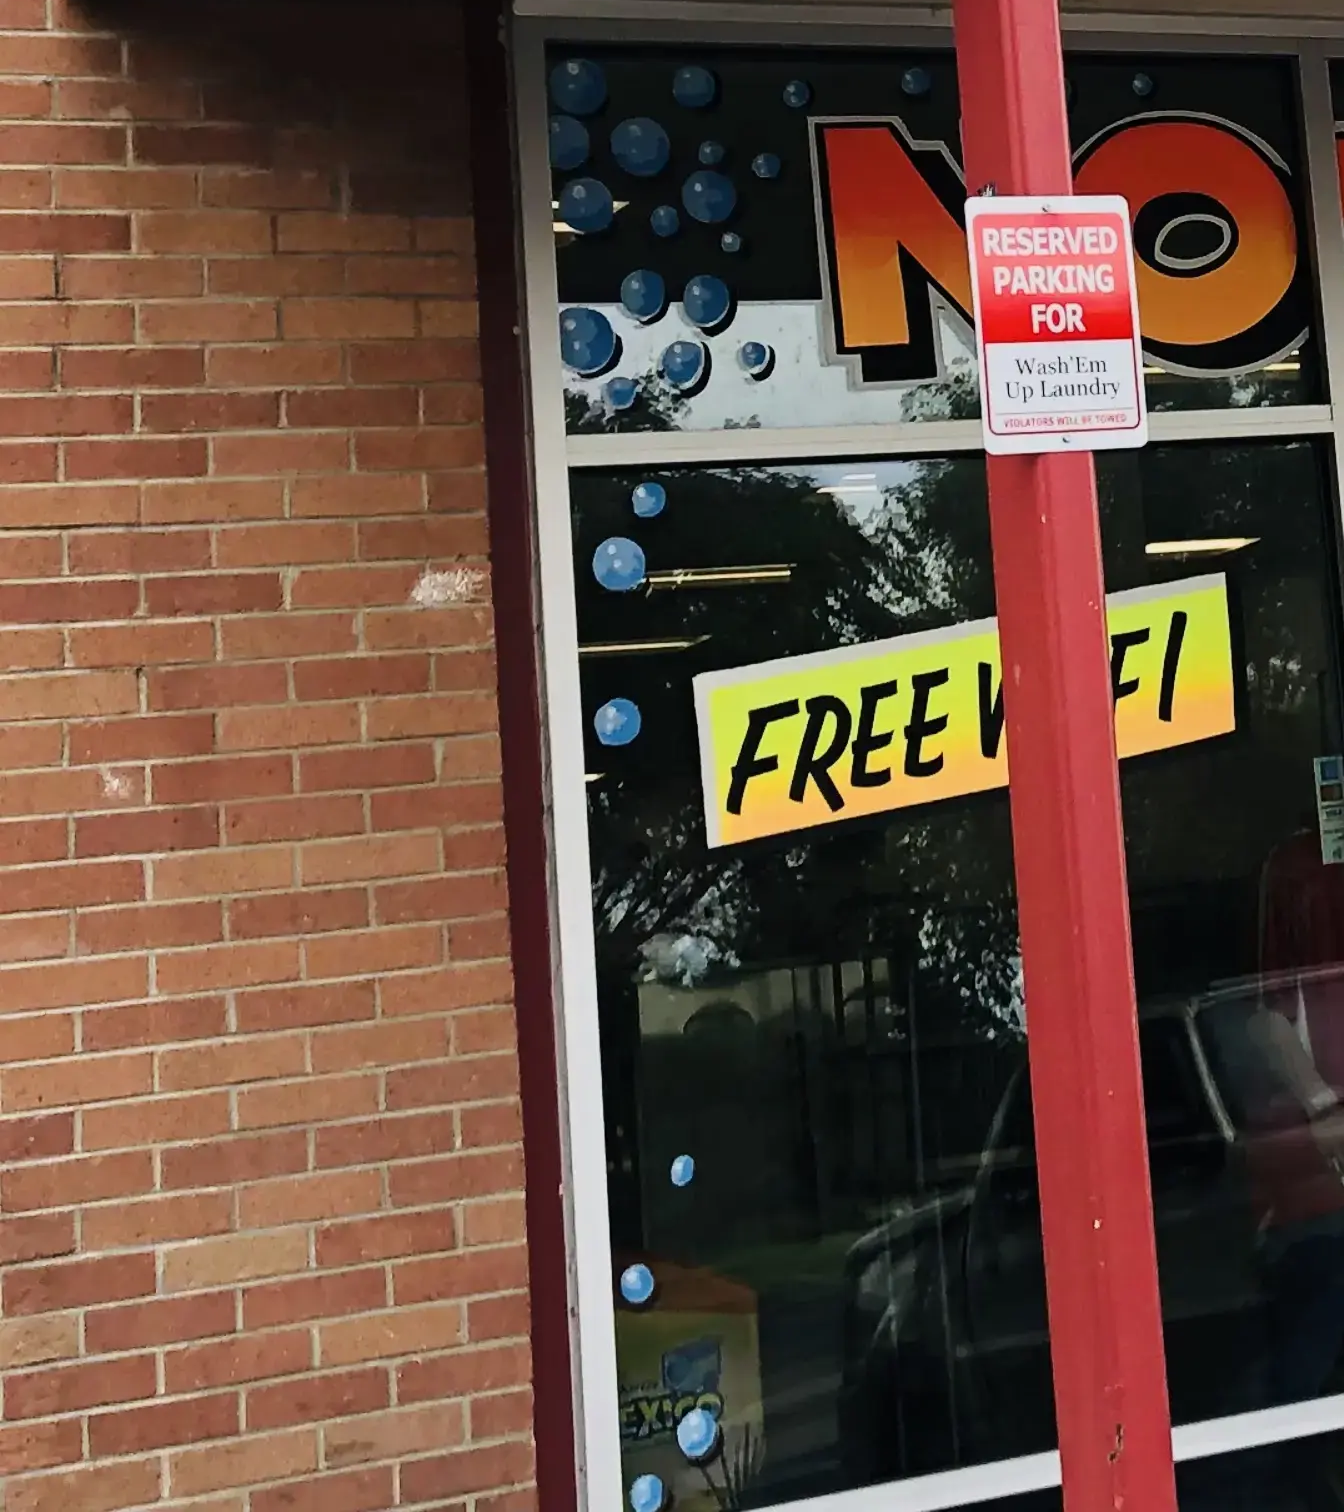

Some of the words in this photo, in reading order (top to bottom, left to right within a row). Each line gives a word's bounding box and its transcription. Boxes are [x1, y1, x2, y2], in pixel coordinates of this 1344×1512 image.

[981, 226, 1118, 257] RESERVED
[993, 264, 1114, 295] PARKING
[1031, 302, 1087, 334] FOR
[1015, 355, 1107, 376] Wash'Em
[1006, 381, 1034, 404] Up
[1041, 377, 1121, 399] Laundry
[1003, 416, 1055, 429] VIOLATORS
[1056, 415, 1079, 426] WILL
[1095, 413, 1128, 424] TOWED
[726, 667, 950, 816] FREE
